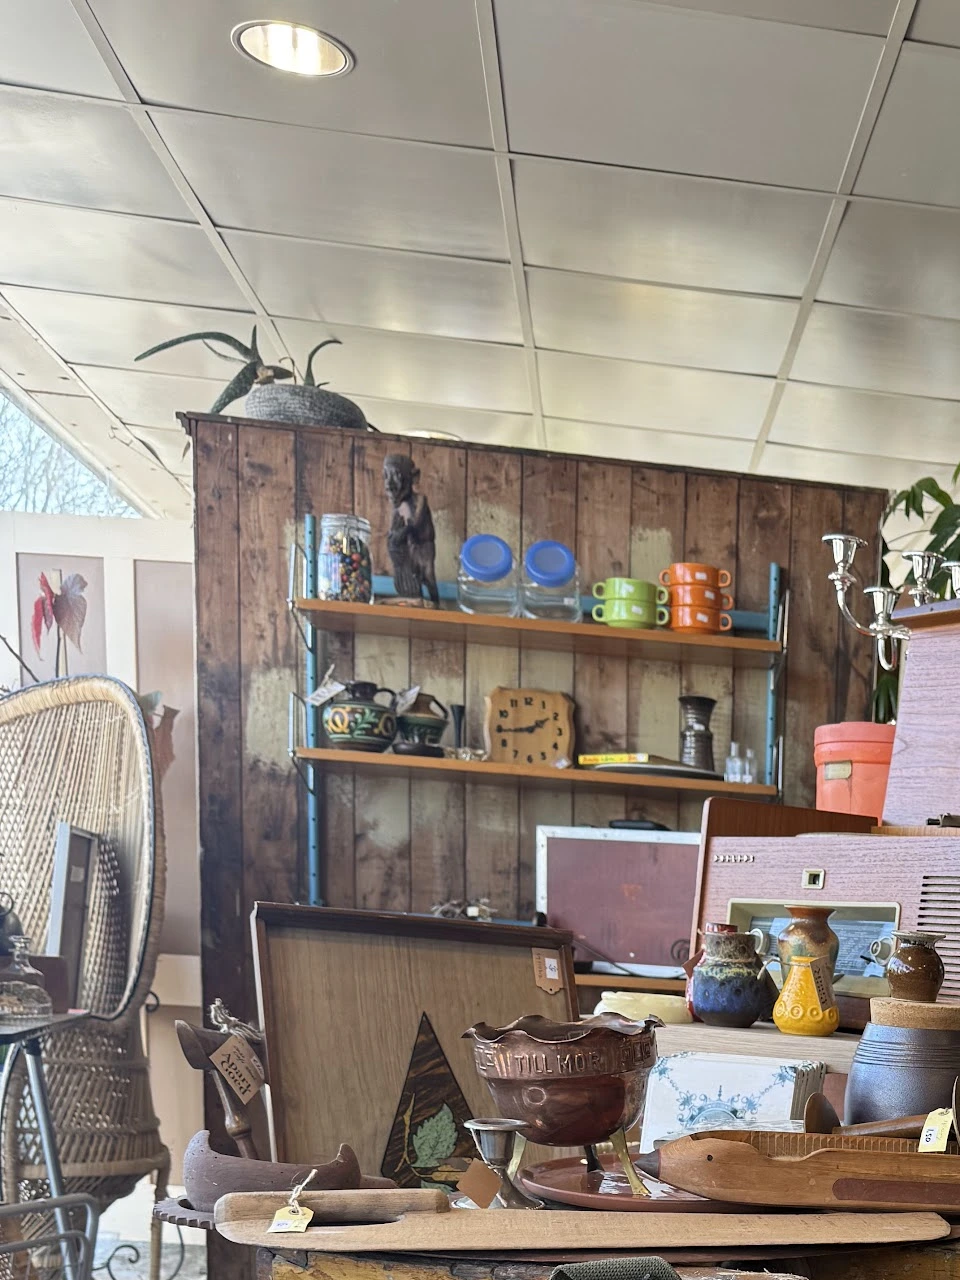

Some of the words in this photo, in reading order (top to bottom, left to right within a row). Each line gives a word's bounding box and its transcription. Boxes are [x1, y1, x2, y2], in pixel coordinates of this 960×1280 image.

[221, 1053, 252, 1093] Apart
[514, 1055, 552, 1074] TILL
[557, 1053, 601, 1075] MOR
